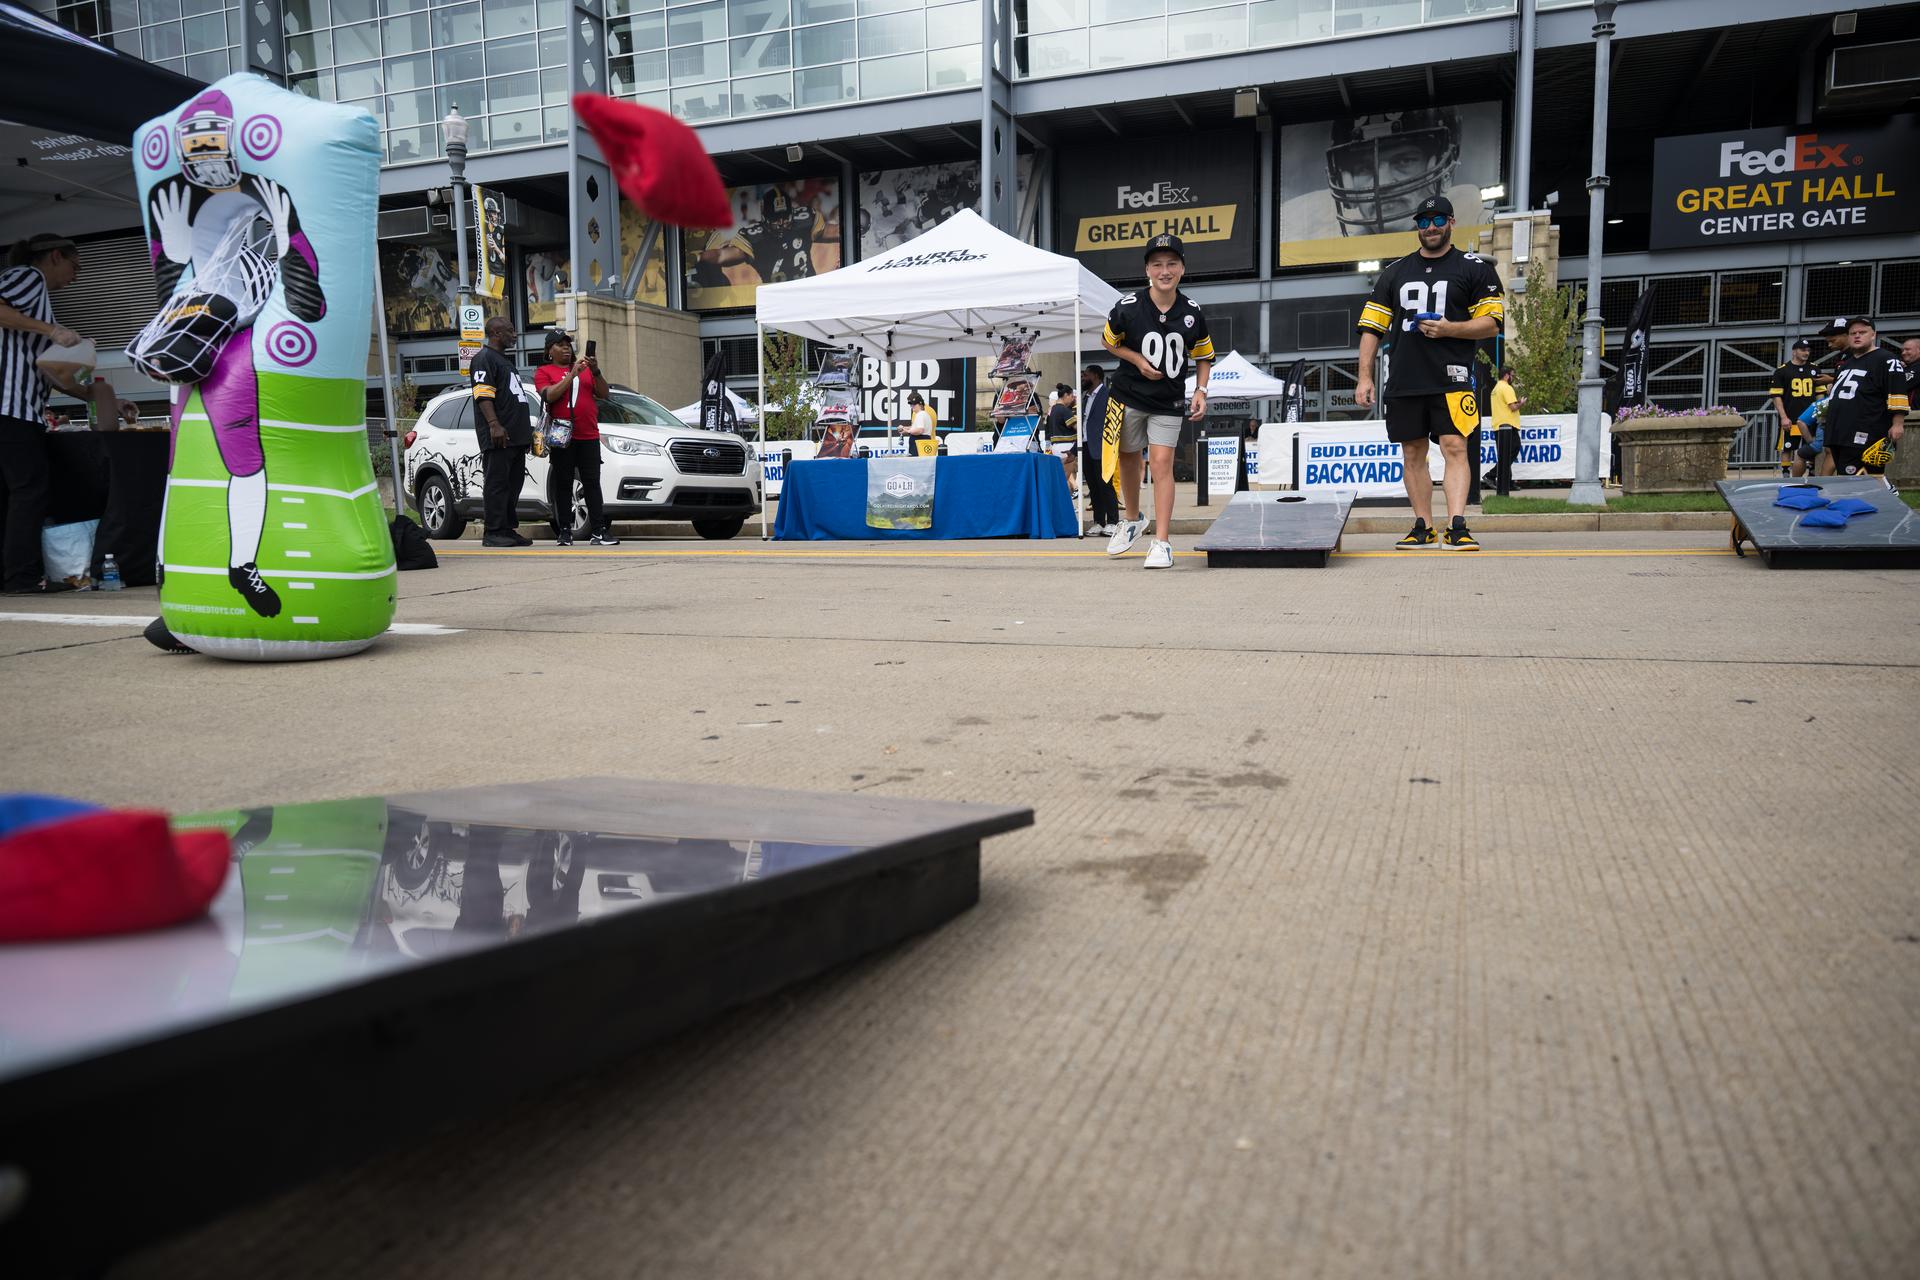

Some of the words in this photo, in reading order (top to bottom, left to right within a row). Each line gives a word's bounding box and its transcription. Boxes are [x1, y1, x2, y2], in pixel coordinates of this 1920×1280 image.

[1718, 134, 1850, 178] FedEx
[1117, 181, 1190, 209] FedEx
[1676, 181, 1792, 214] GREAT
[1802, 172, 1897, 204] HALL
[1087, 220, 1157, 243] GREAT
[1163, 215, 1221, 236] HALL
[1700, 212, 1795, 236] CENTER
[1802, 206, 1868, 228] GATE
[866, 254, 989, 273] HIGHLANDS
[884, 248, 970, 265] LAUREL
[1399, 280, 1449, 332] 91
[1141, 331, 1185, 379] 90
[473, 370, 487, 383] 47
[862, 357, 940, 389] BUD
[1828, 368, 1868, 401] 75
[1791, 377, 1813, 397] 90
[1521, 428, 1558, 440] IGHT
[1208, 447, 1237, 455] BACKYARD
[1311, 446, 1347, 458] BUD
[1349, 444, 1400, 457] LIGHT
[1480, 444, 1562, 464] BAYARD
[1306, 461, 1403, 485] BACKYARD
